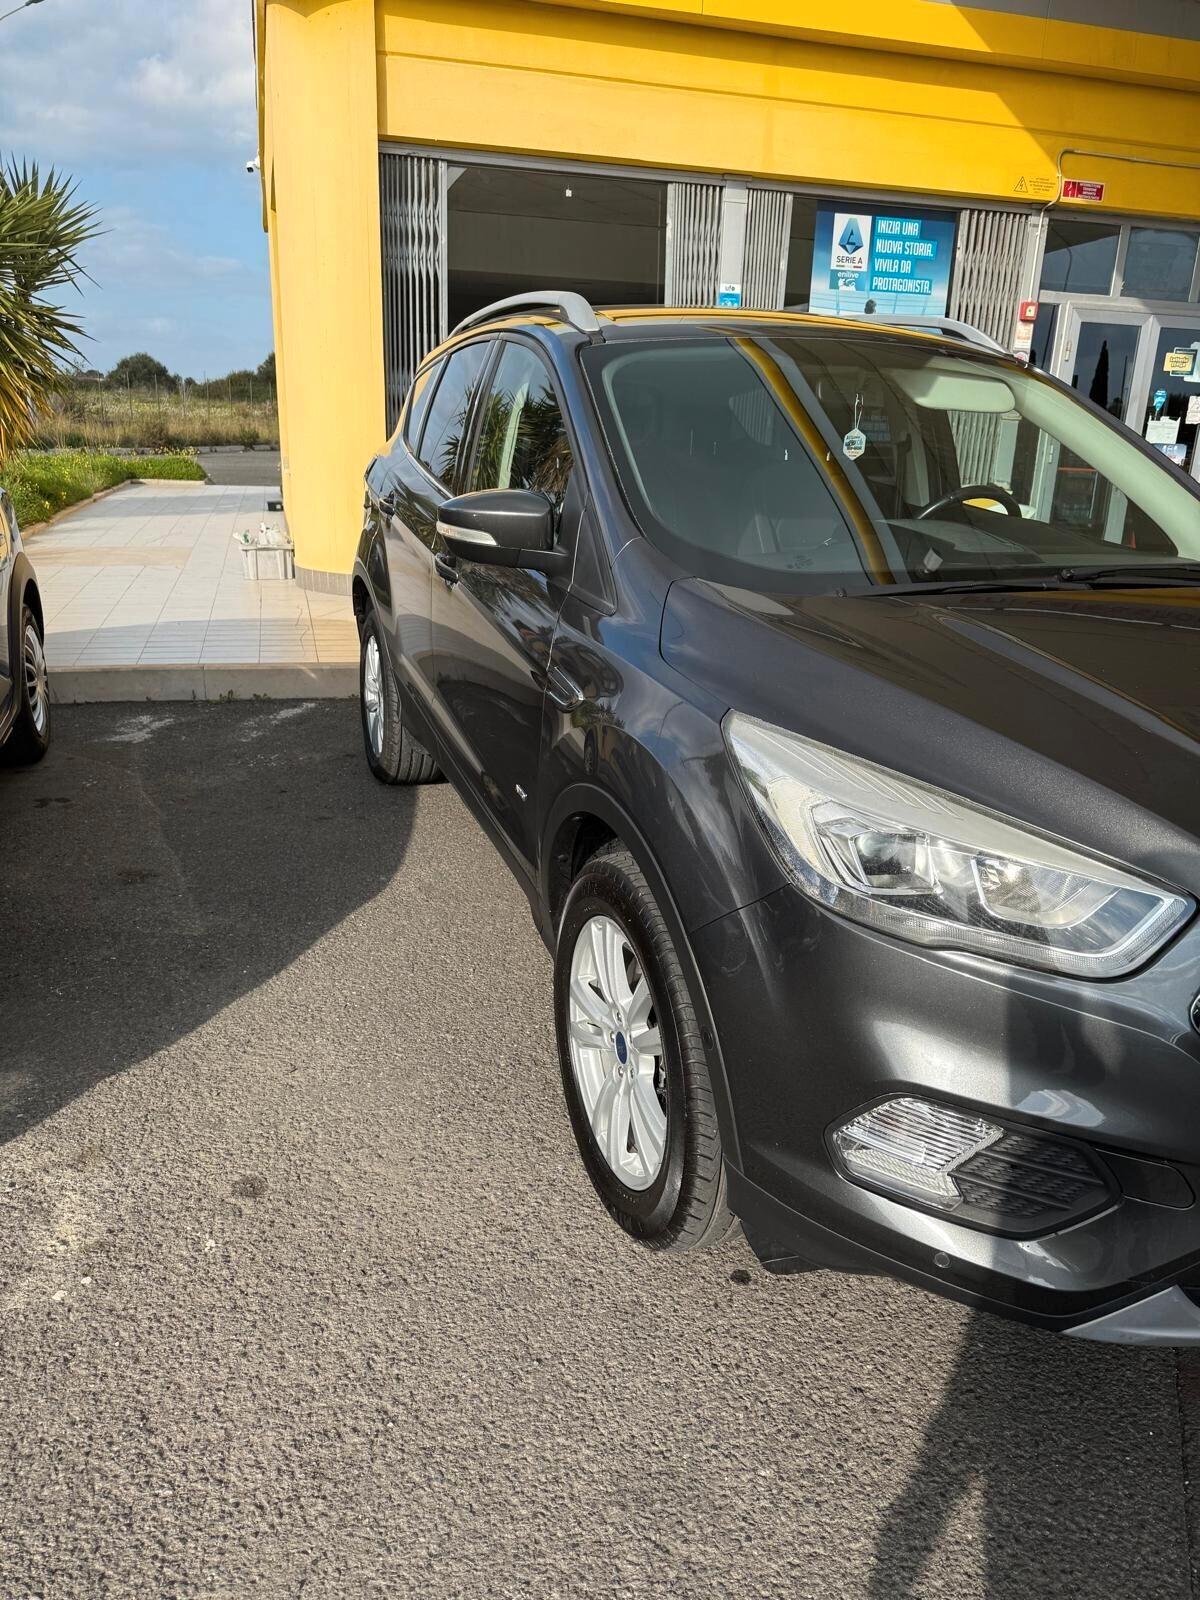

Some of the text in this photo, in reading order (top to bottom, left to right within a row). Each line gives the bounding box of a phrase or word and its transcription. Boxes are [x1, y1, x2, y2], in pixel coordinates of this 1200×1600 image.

[877, 220, 919, 236] INIZIA UNA
[876, 239, 934, 257] NUOVA STORIA.
[836, 255, 857, 264] SERIE
[874, 258, 911, 273] VIVILA DA
[872, 277, 931, 293] PROTAGONISTA.
